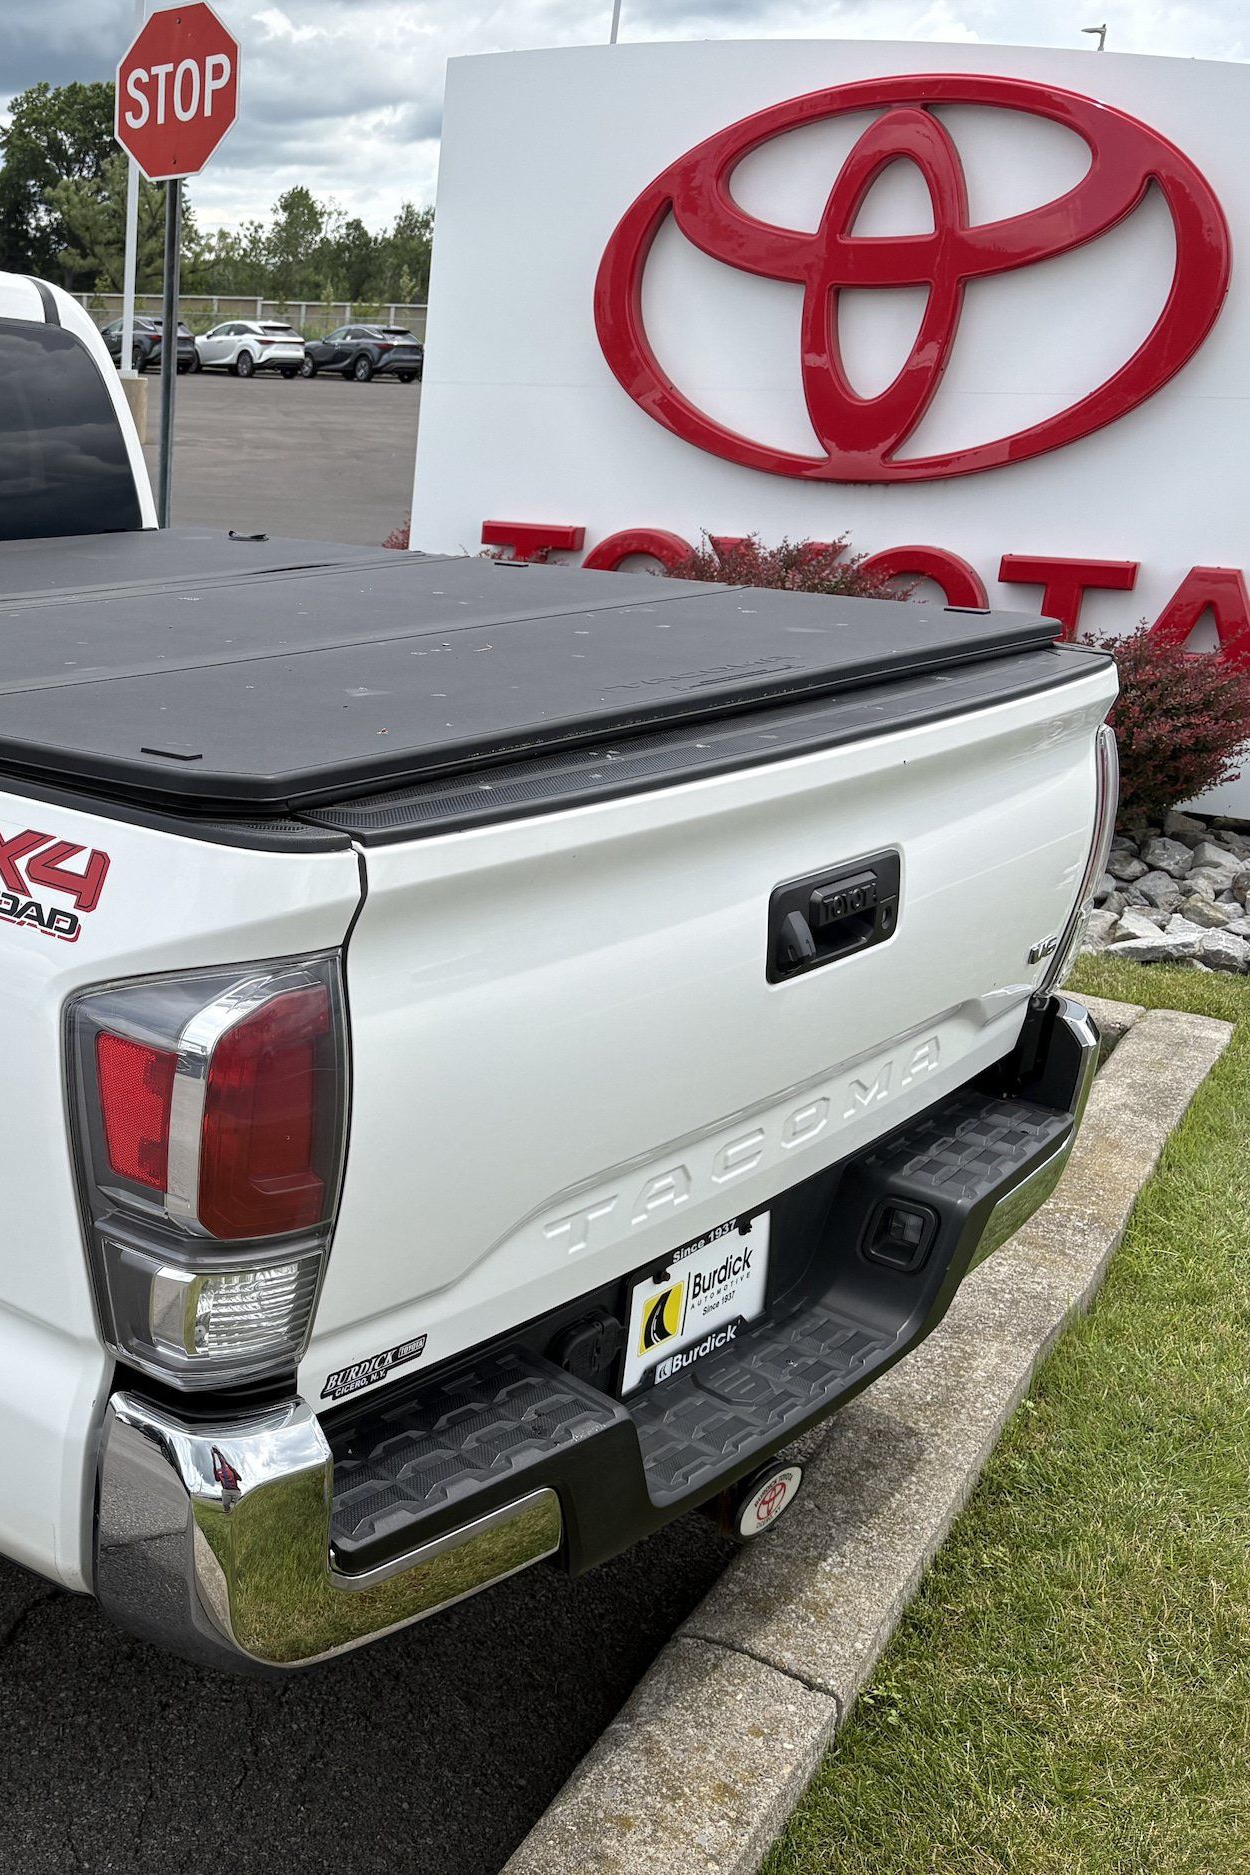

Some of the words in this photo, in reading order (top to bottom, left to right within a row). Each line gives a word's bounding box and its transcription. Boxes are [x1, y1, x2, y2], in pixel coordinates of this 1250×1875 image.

[125, 53, 231, 129] STOP
[543, 1034, 941, 1254] TACOMA
[672, 1237, 705, 1264] Since
[707, 1219, 737, 1245] 1937
[691, 1271, 751, 1310] AUTOMOTIVE
[692, 1246, 753, 1300] Burdick
[702, 1300, 720, 1316] Since
[721, 1290, 736, 1305] 1937
[326, 1349, 397, 1391] BURDICK
[672, 1324, 737, 1374] Burdick
[335, 1377, 368, 1397] CICERO,
[370, 1369, 386, 1382] N.Y.
